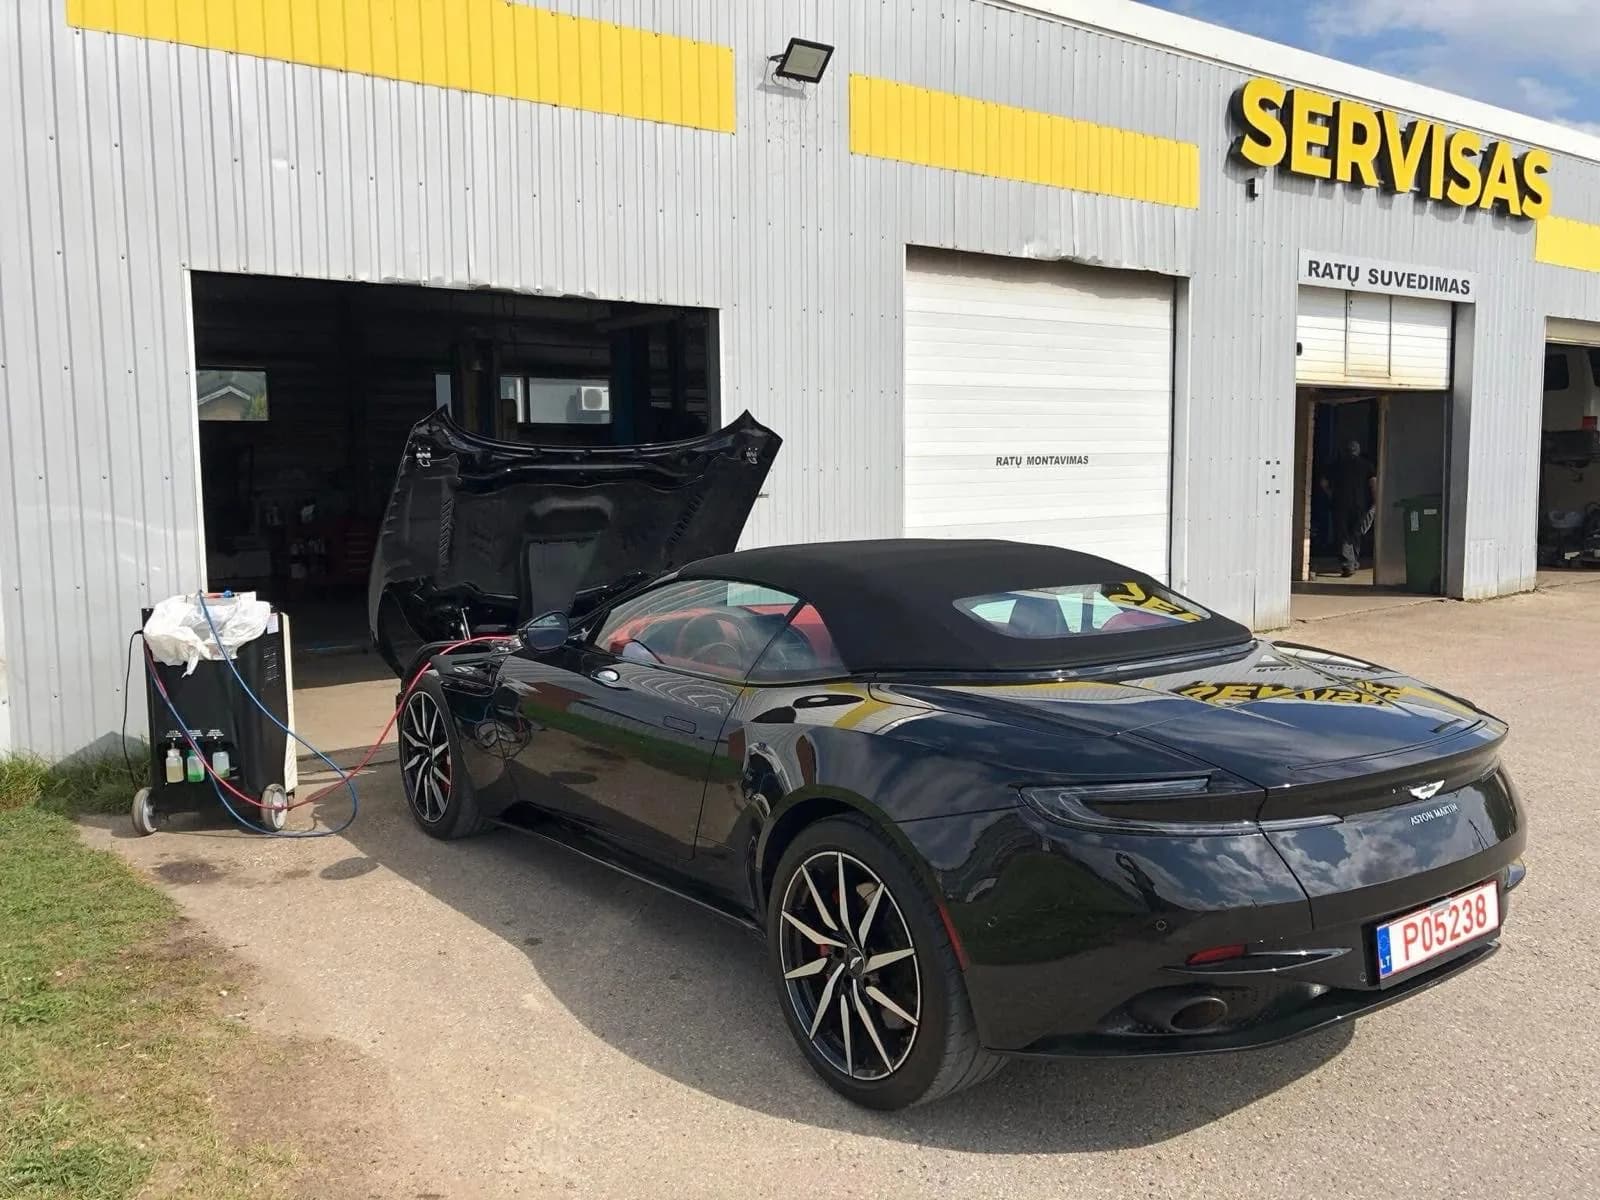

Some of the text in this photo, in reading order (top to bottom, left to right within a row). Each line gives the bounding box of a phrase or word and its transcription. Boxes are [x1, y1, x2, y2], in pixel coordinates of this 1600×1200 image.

[1240, 77, 1552, 220] SERVISAS
[1308, 260, 1471, 295] RATŲ SUVEDIMAS
[995, 455, 1089, 468] RATŲ MONTAVIMAS
[1410, 803, 1458, 826] ASTON MARTIN
[1403, 894, 1487, 961] P05238
[1380, 955, 1390, 969] LT
